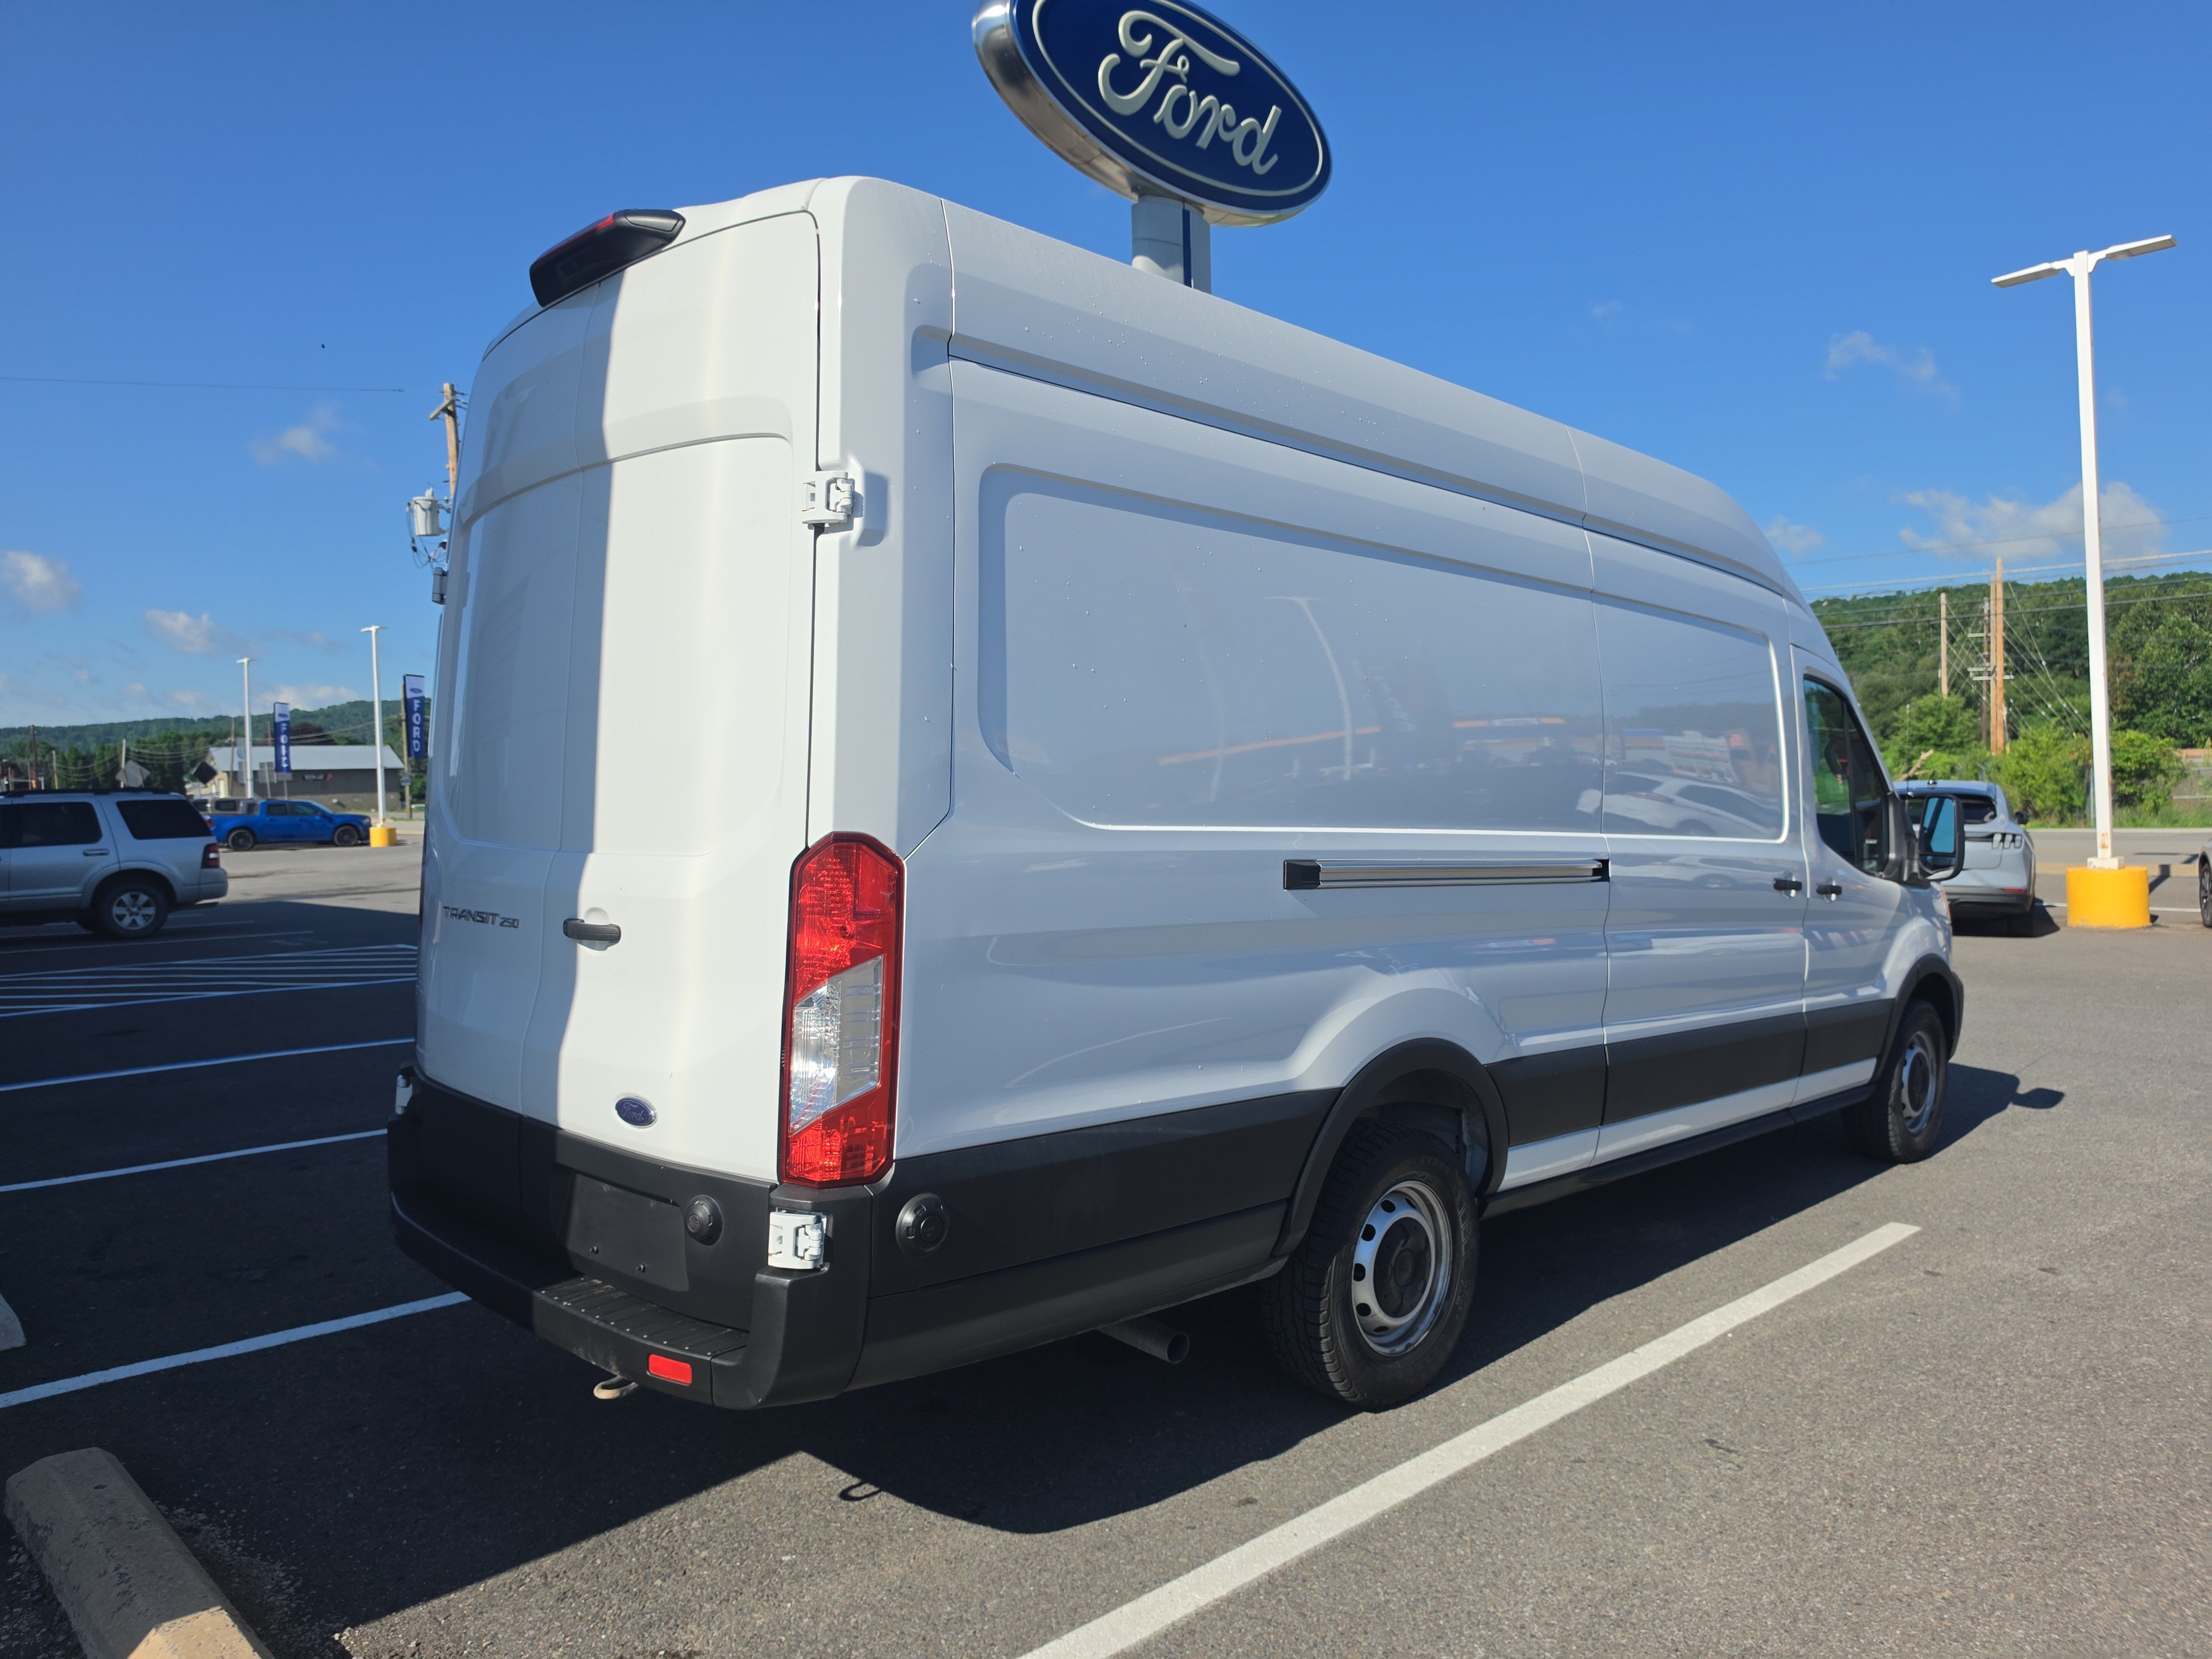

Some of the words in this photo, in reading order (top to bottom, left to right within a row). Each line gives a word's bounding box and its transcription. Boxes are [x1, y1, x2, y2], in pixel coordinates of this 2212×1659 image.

[1098, 10, 1282, 175] Ford
[412, 699, 421, 753] FORD
[443, 906, 500, 925] TRANSIT
[621, 1102, 644, 1121] Ford
